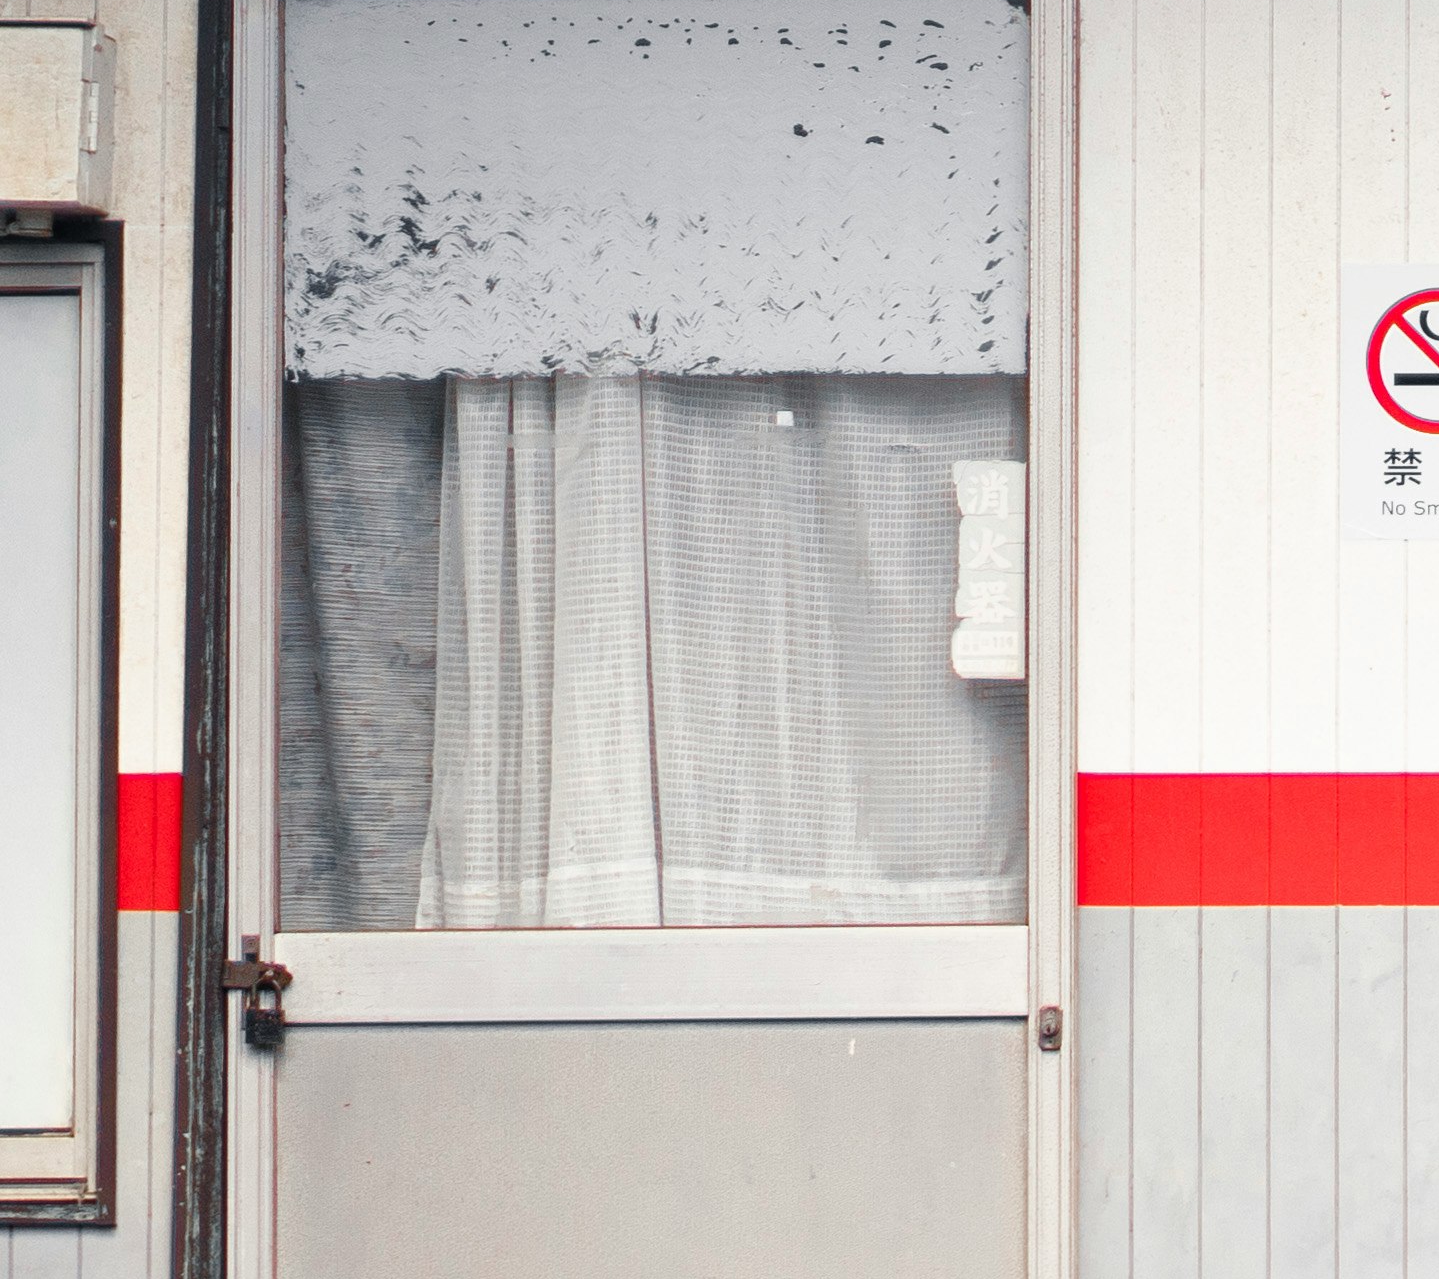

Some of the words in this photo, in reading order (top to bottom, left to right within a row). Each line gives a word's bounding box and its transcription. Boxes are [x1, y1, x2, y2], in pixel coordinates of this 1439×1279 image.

[966, 469, 1017, 624] 消火器
[1382, 500, 1406, 516] No
